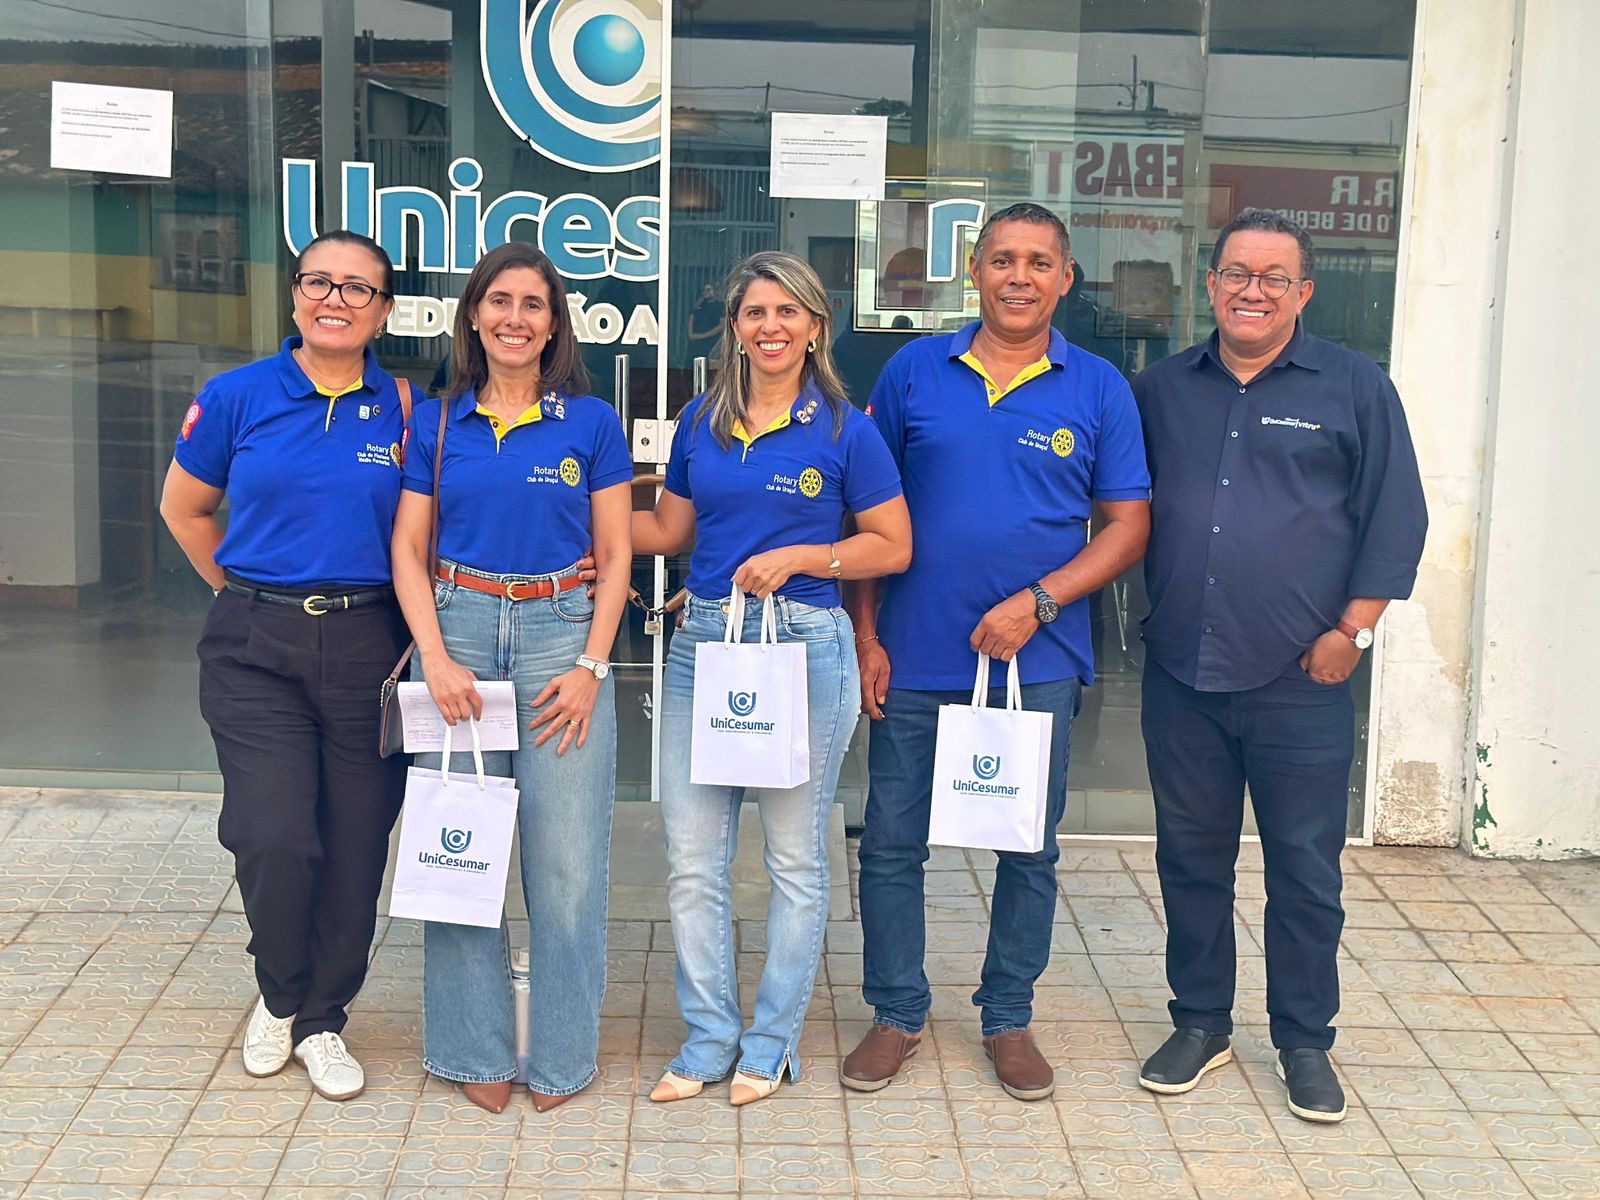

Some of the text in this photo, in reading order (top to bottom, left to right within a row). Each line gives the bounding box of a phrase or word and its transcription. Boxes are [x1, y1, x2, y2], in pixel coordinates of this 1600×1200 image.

[1026, 429, 1052, 444] Rotary
[366, 443, 389, 455] Rotary
[533, 466, 559, 477] Rotary
[774, 475, 798, 487] Rotary
[710, 717, 775, 731] UniCesumar
[953, 779, 1020, 796] UniCesumar
[418, 851, 491, 871] UniCesumar
